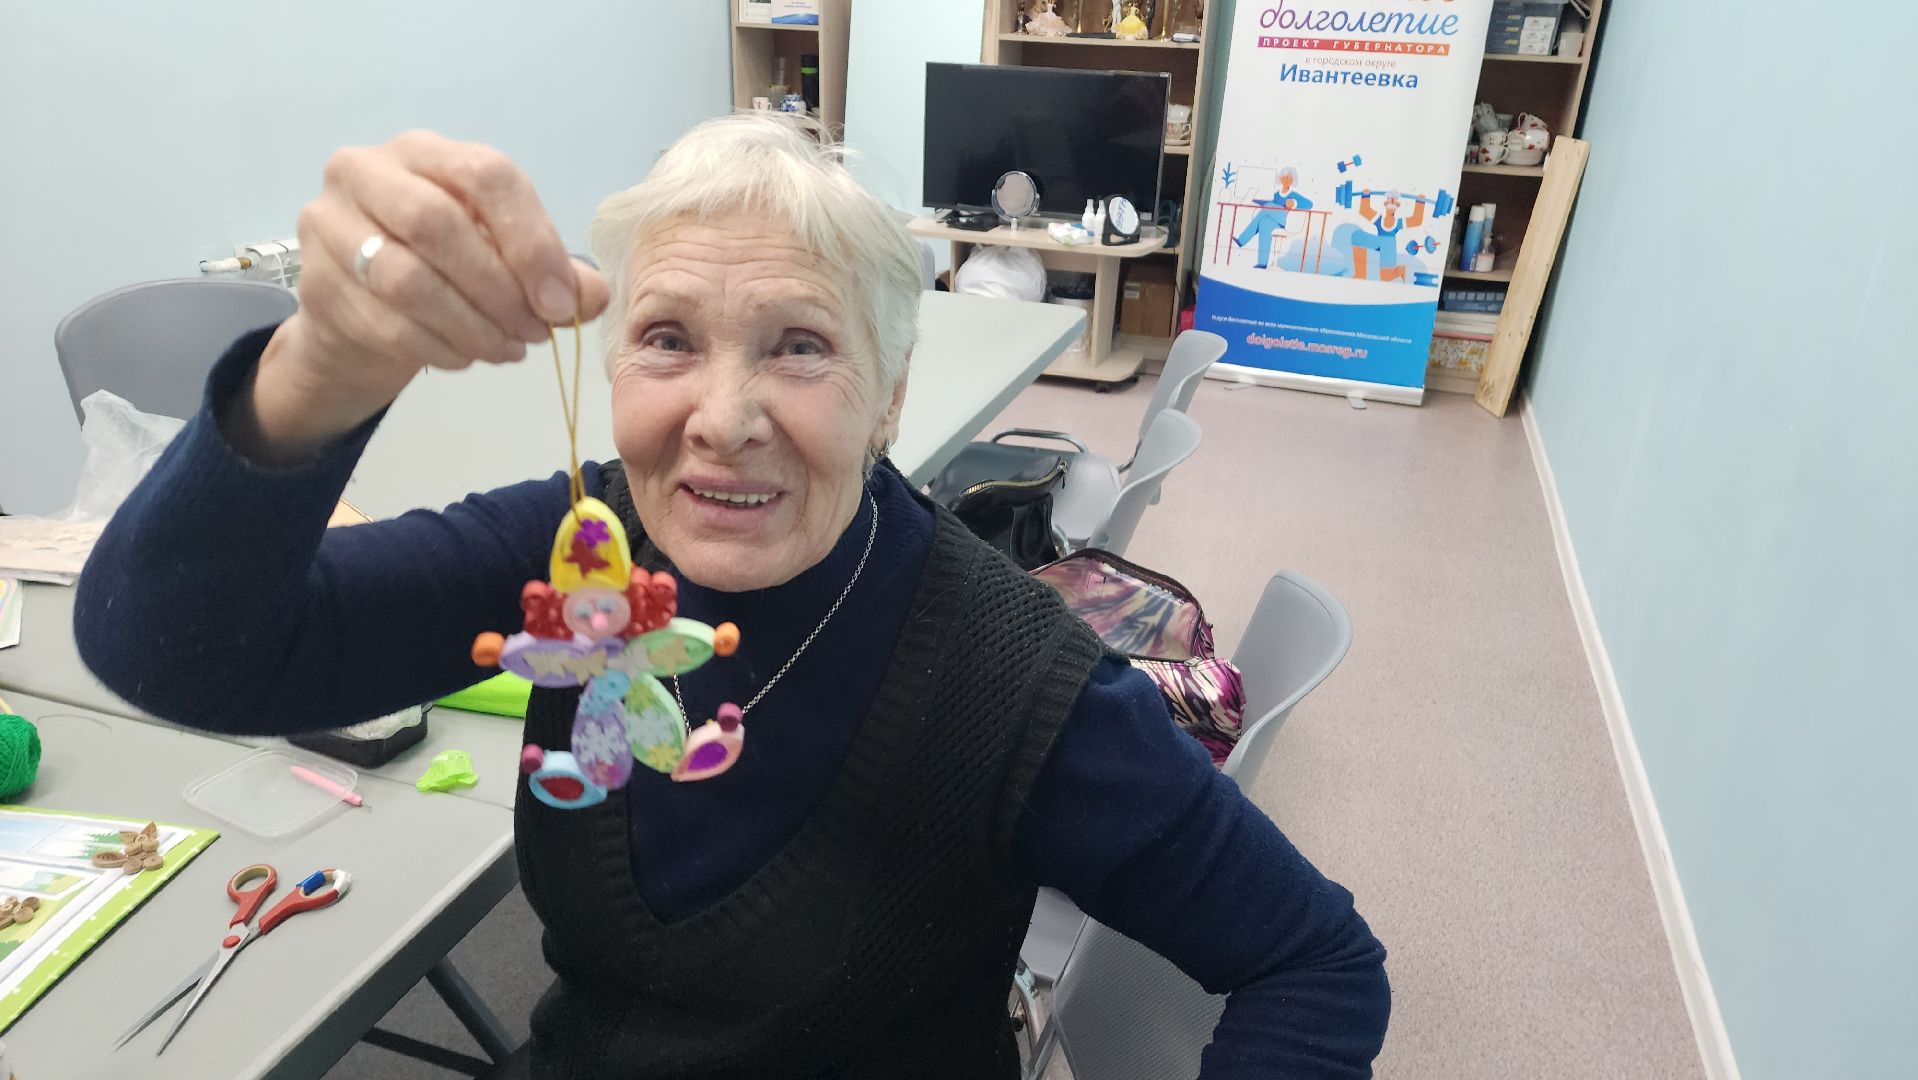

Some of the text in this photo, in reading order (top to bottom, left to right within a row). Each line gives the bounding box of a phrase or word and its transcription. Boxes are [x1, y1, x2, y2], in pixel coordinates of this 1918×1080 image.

[1260, 0, 1459, 36] долголетие
[1263, 37, 1446, 55] ПРОЕКТ ГУБЕРНАТОРА
[1313, 57, 1362, 67] городском
[1365, 60, 1396, 69] округе
[1280, 63, 1419, 89] Ивантеевка
